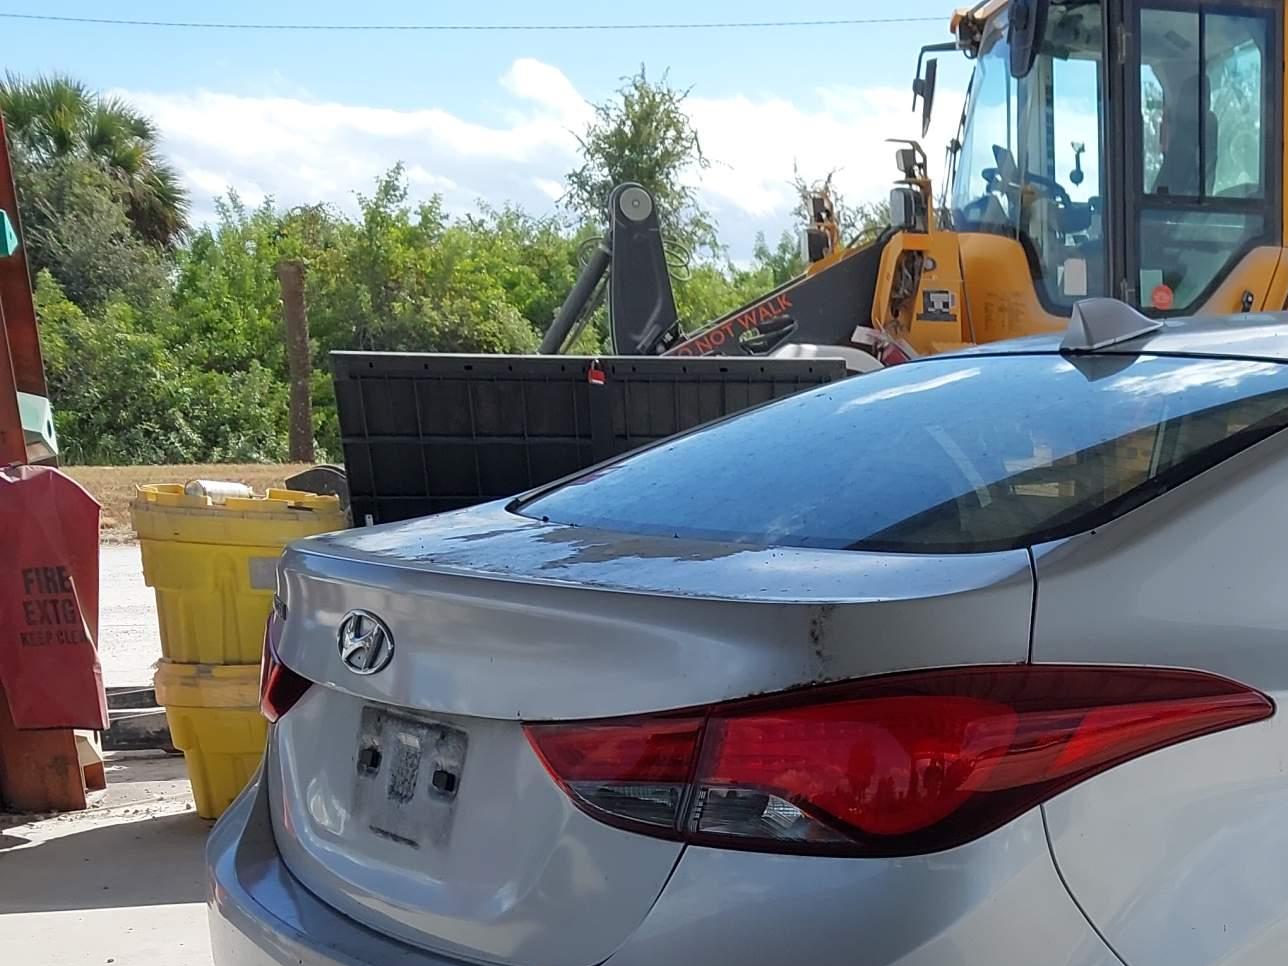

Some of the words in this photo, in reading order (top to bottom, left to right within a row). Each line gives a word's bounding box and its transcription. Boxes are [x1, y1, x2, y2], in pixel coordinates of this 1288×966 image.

[694, 322, 734, 353] NOT
[737, 294, 793, 331] WALK
[22, 566, 73, 594] FIRE
[23, 598, 76, 625] EXTG
[20, 630, 52, 647] KEEP
